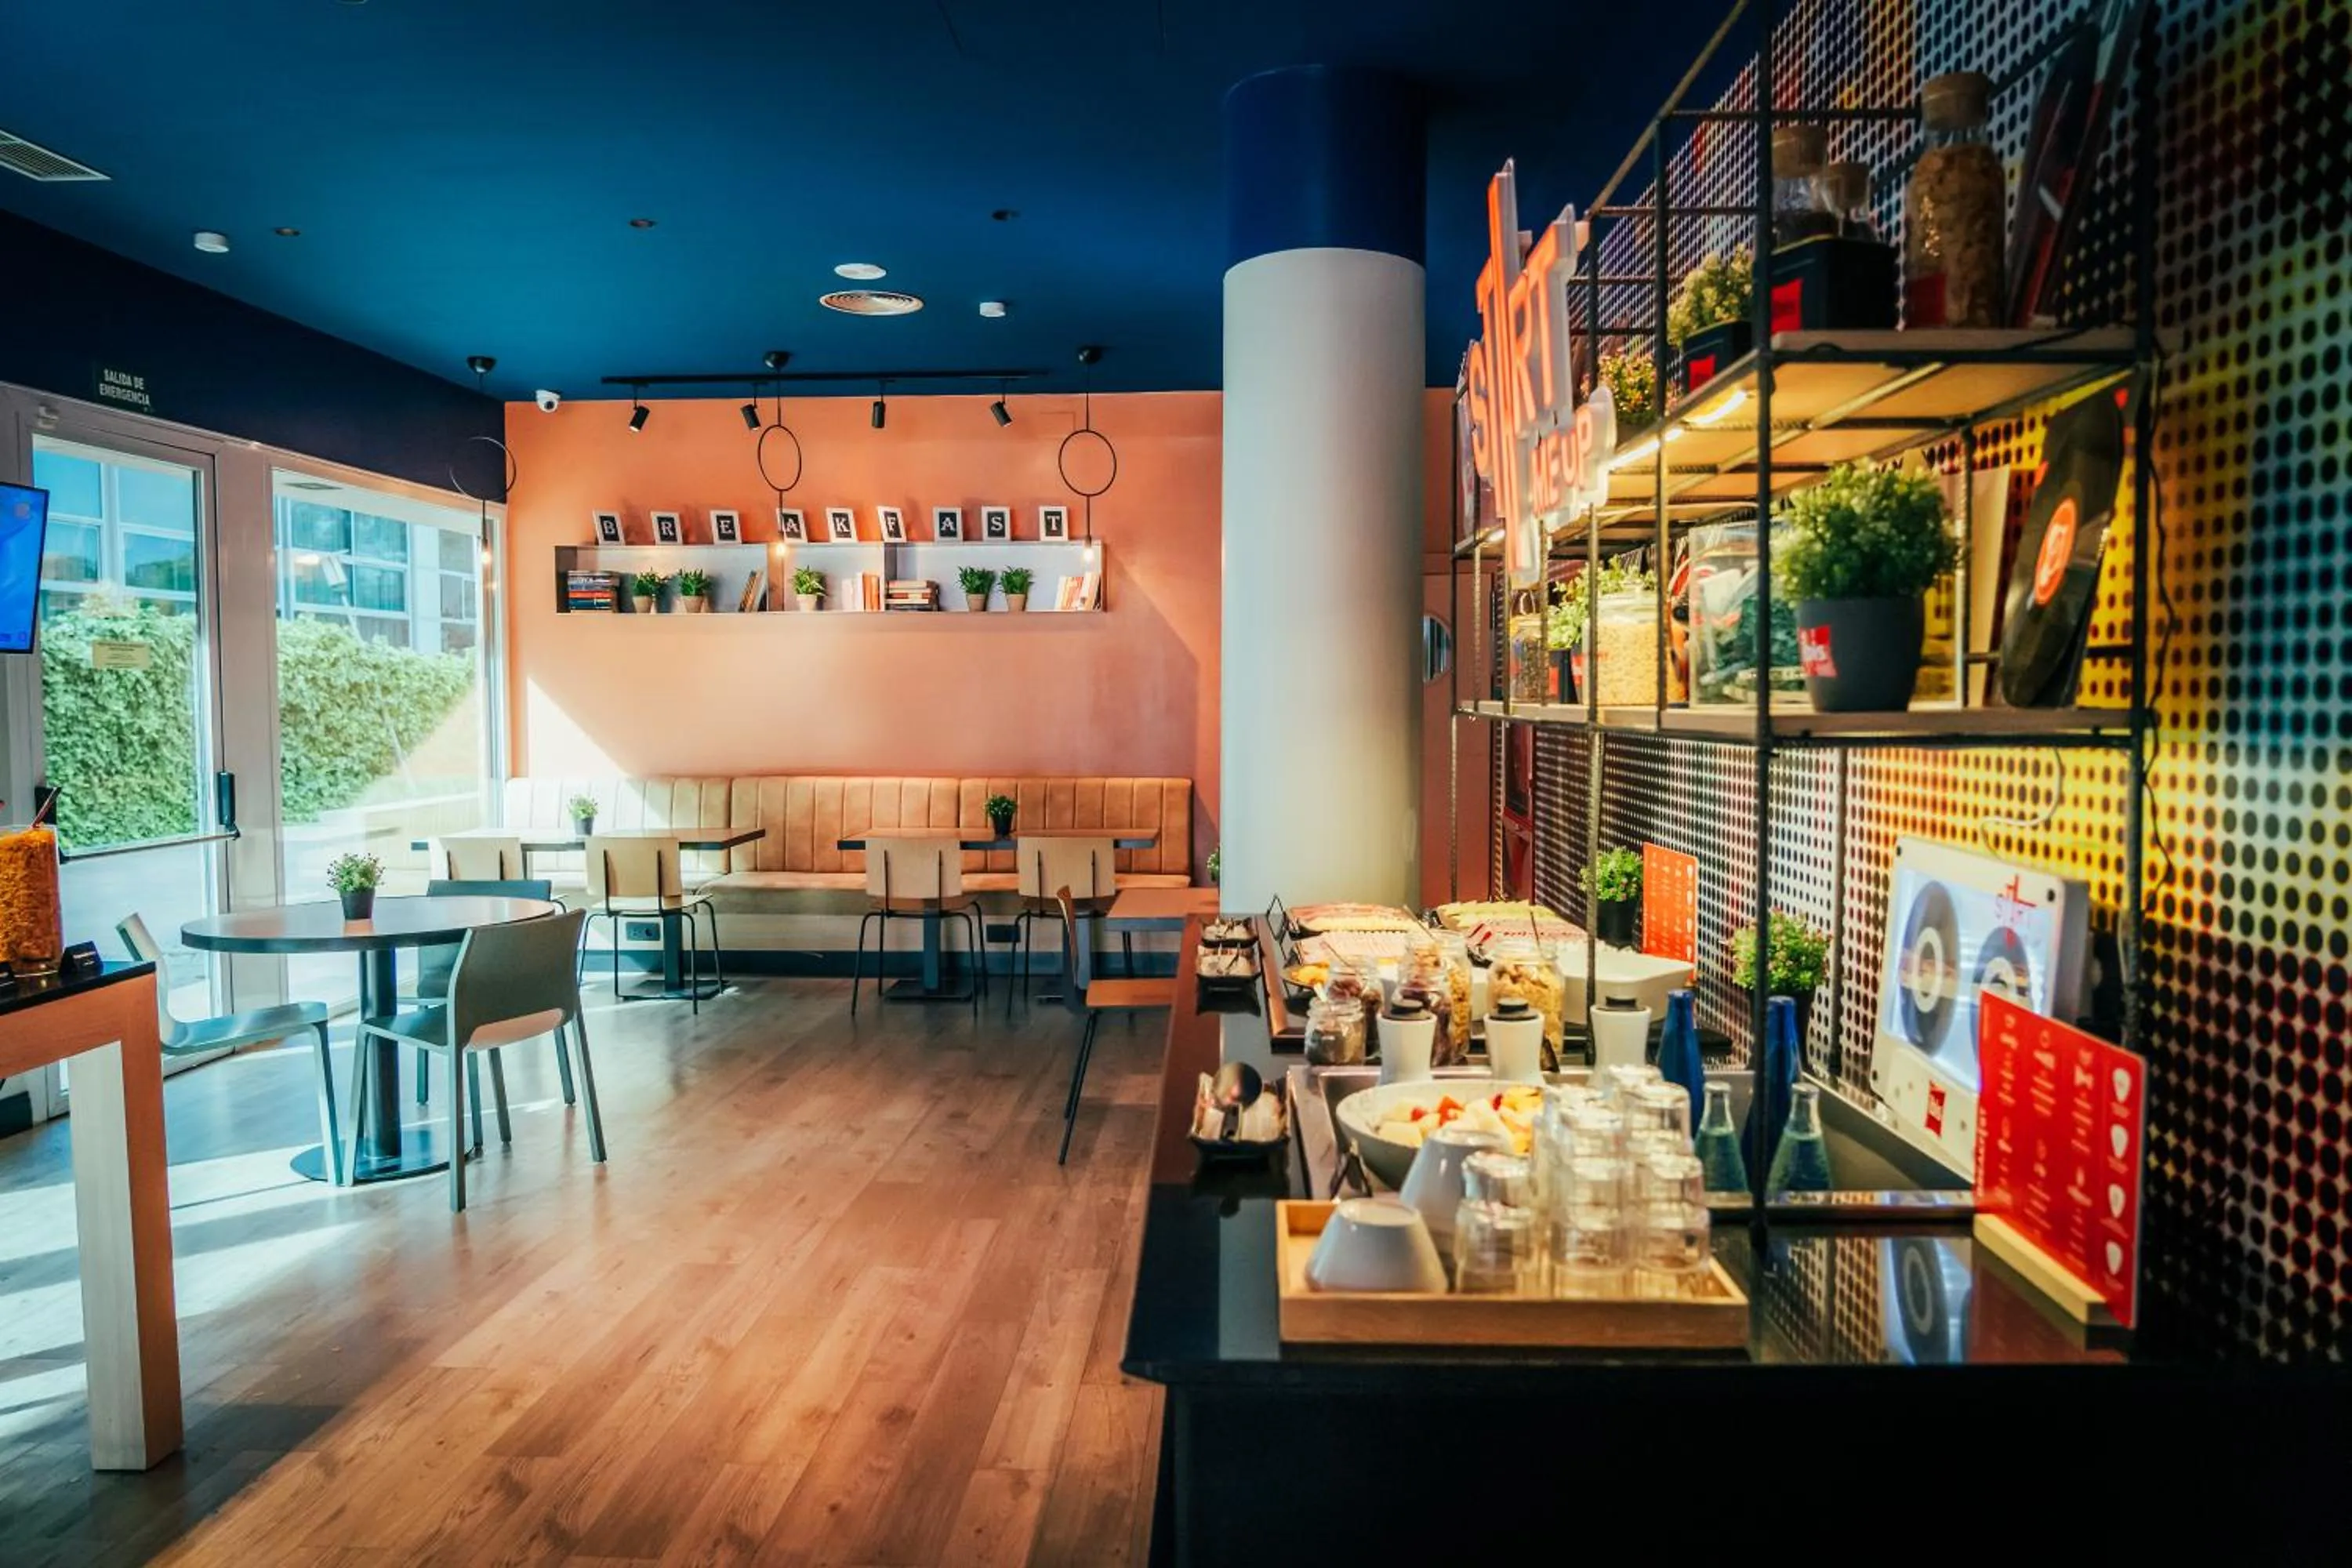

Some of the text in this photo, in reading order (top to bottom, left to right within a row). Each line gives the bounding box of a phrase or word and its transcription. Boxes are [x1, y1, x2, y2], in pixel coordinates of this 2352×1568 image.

[103, 368, 144, 390] SALIDA DE
[100, 383, 151, 406] EMERGENCIA
[1531, 405, 1594, 514] ME UP
